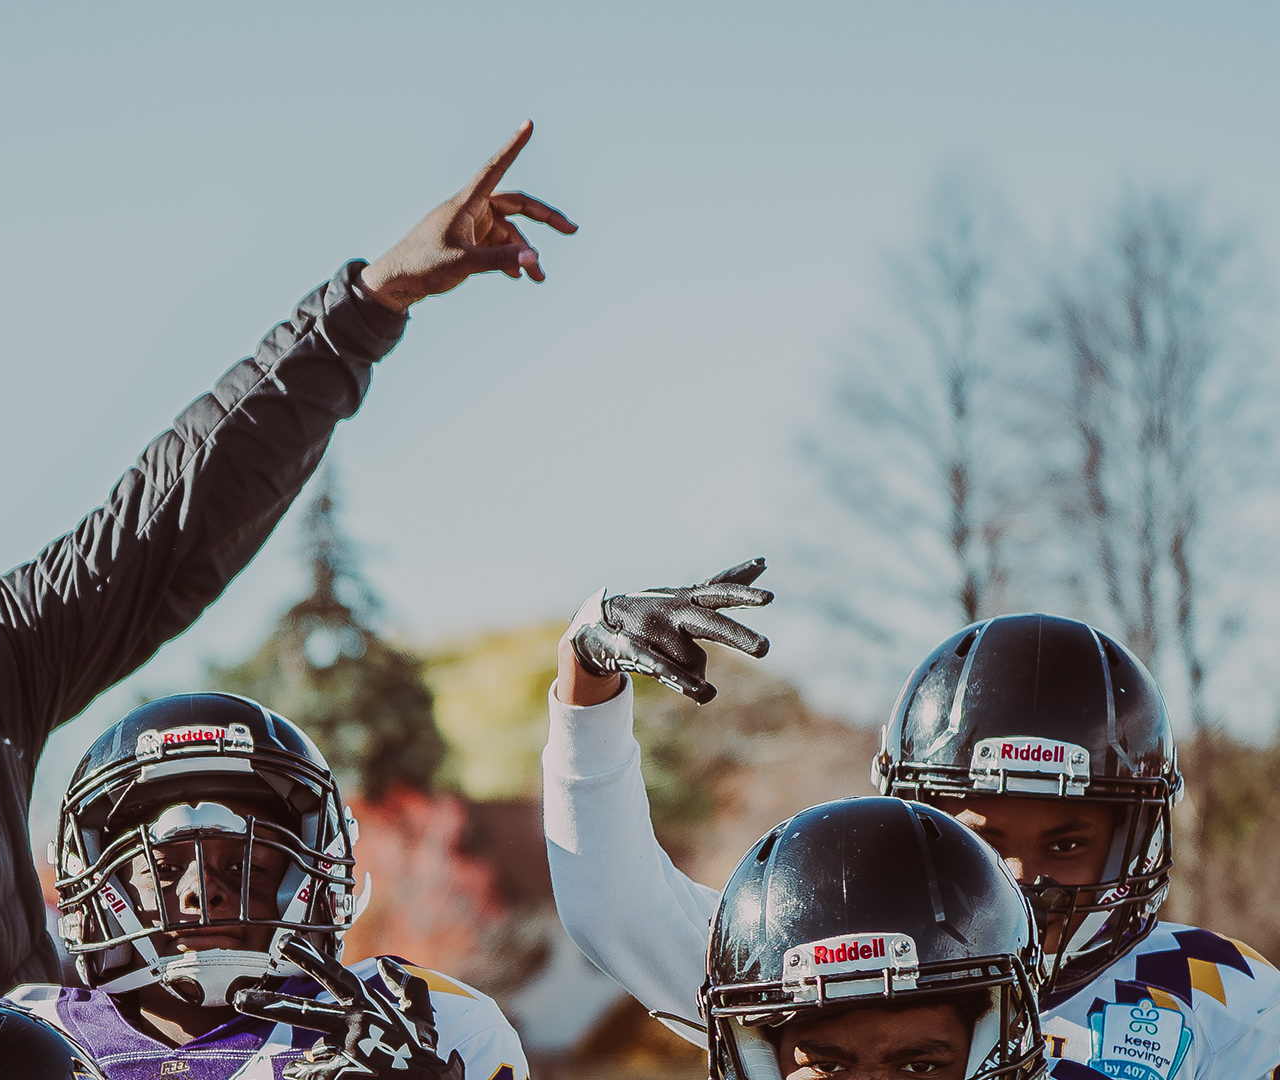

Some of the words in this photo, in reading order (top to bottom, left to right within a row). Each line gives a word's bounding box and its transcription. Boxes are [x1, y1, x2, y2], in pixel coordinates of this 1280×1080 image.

[163, 728, 225, 745] Riddell
[1001, 743, 1064, 763] Riddell
[814, 938, 885, 964] Riddell
[1124, 1033, 1161, 1051] keep
[1124, 1065, 1146, 1079] 407
